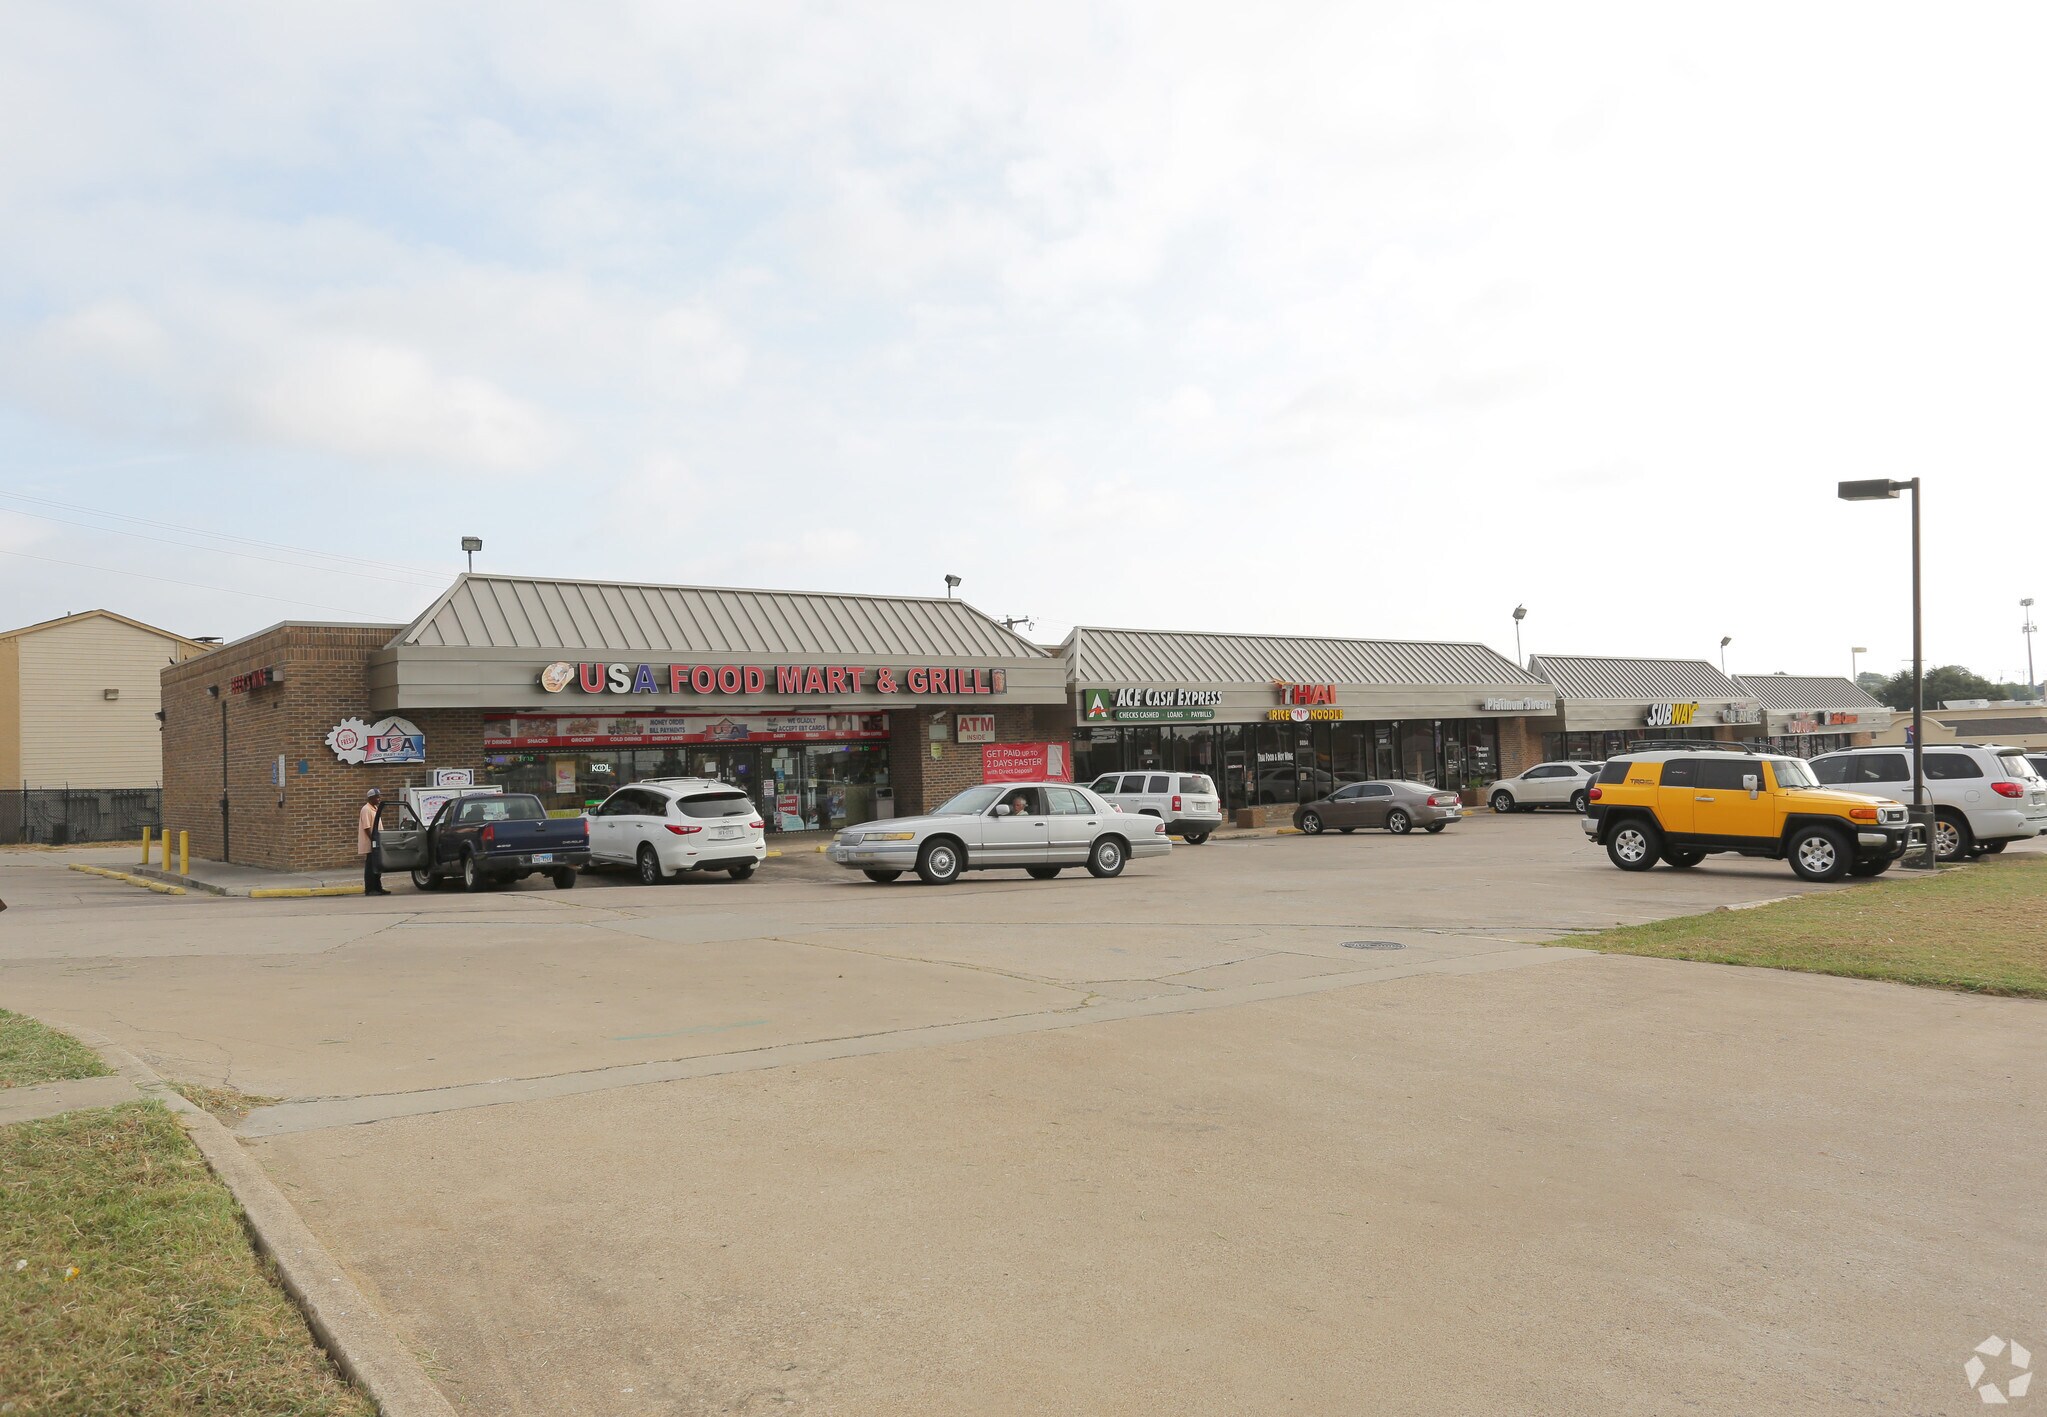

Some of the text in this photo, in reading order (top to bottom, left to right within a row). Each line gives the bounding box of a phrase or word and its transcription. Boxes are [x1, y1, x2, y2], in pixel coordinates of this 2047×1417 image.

[578, 663, 990, 694] USA FOOD MART & GRILL
[1116, 688, 1142, 707] ACE
[1281, 682, 1337, 705] THAI
[1485, 697, 1551, 710] Platinum Shears
[1271, 709, 1291, 720] RICE
[1310, 709, 1344, 720] NOODLE
[1647, 703, 1699, 726] SUBWAY
[713, 726, 740, 735] USA
[958, 717, 994, 732] ATM
[341, 737, 355, 746] FRESH
[376, 736, 417, 753] USA
[986, 750, 1001, 758] GET
[1003, 749, 1021, 757] PAID
[591, 763, 611, 772] KOOL
[993, 759, 1013, 767] DAYS
[1014, 758, 1042, 766] FASTER
[1014, 767, 1033, 775] Deposit
